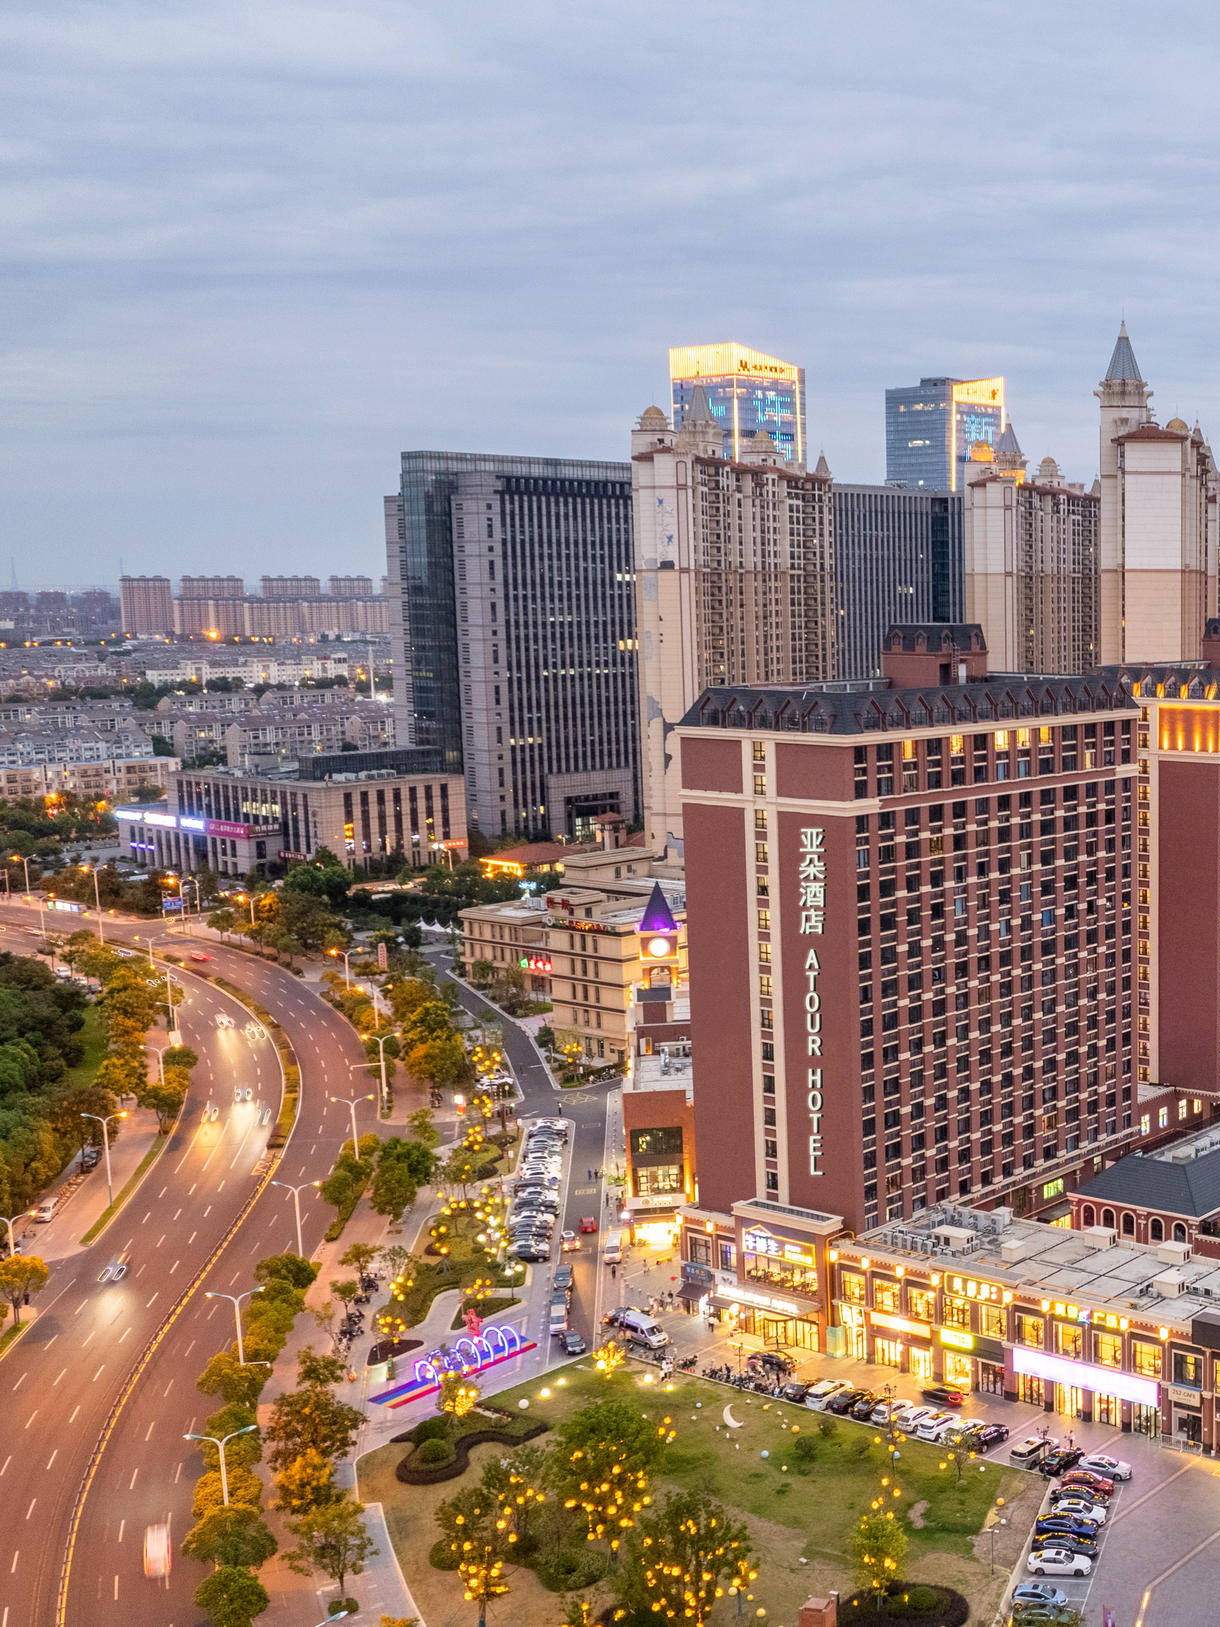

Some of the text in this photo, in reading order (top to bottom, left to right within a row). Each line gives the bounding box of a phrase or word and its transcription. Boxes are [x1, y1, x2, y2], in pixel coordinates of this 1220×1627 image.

[799, 828, 826, 935] 亚朵酒店
[805, 949, 824, 1176] ATOUR HOTEL
